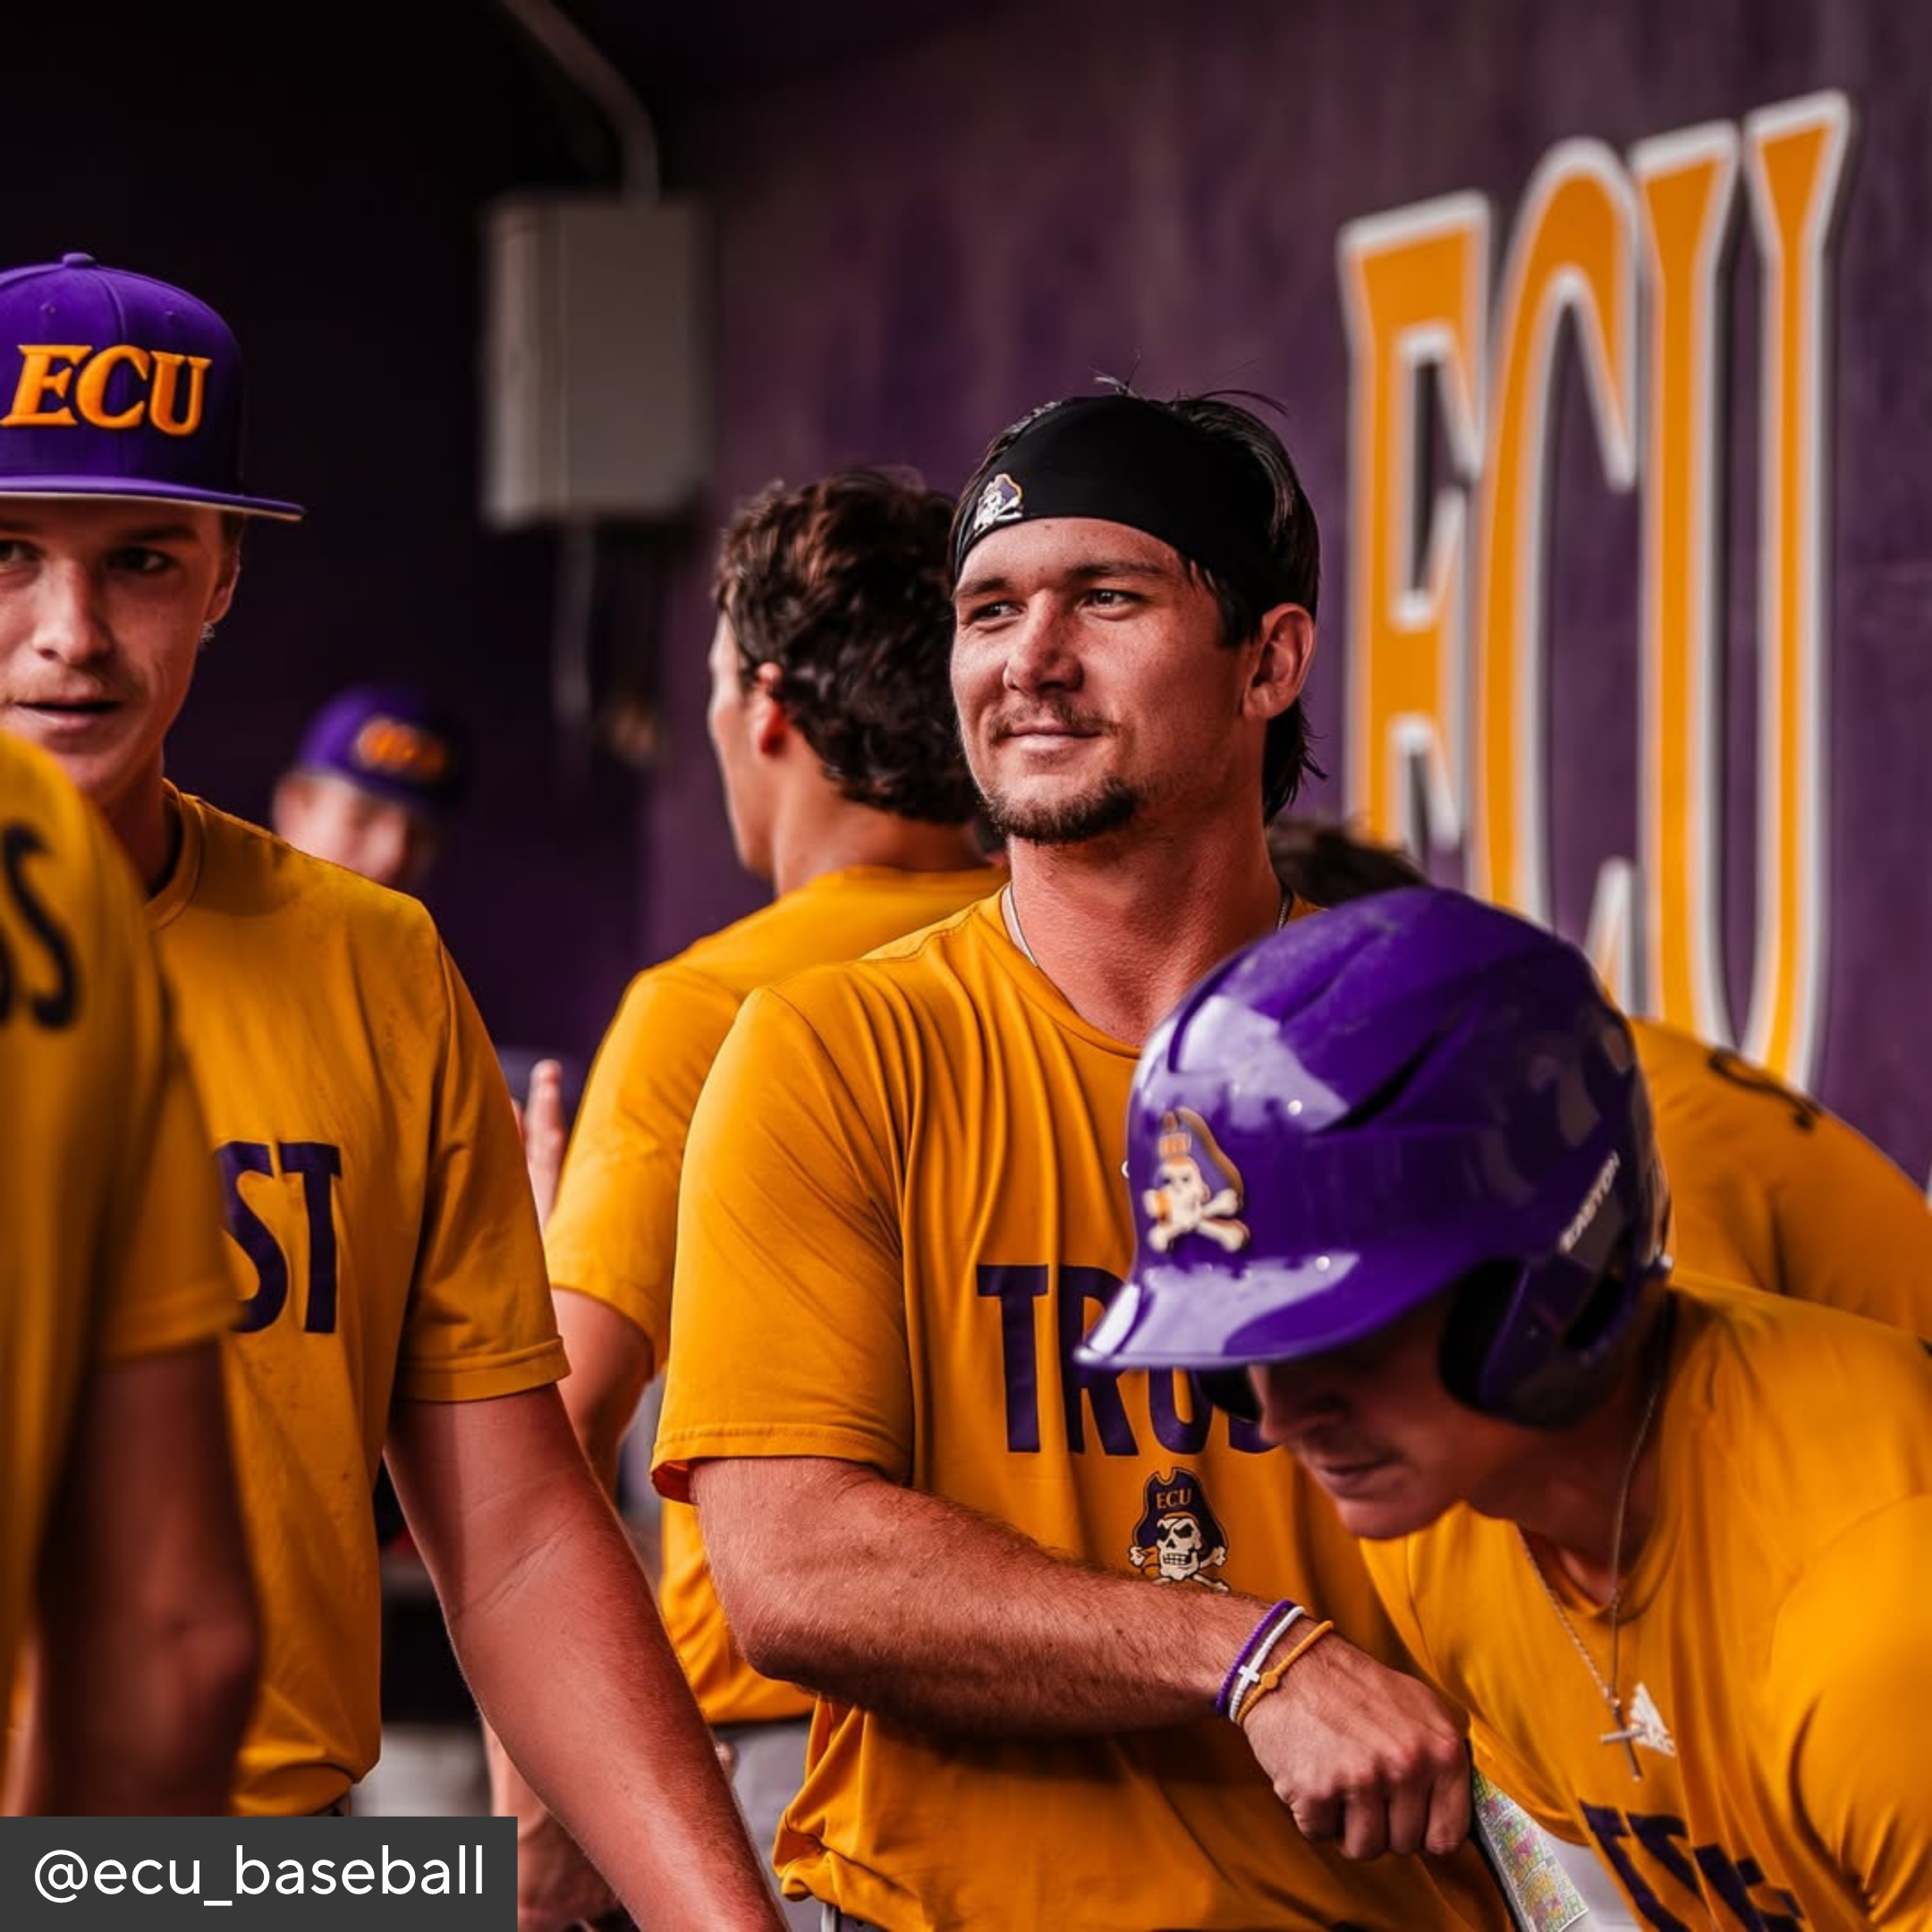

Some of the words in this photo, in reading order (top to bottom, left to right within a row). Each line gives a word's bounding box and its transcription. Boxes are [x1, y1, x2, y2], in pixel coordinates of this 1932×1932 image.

[0, 343, 212, 436] ECU
[1336, 89, 1851, 1092] ECU
[976, 1264, 1285, 1456] TR
[1156, 1487, 1192, 1510] ECU
